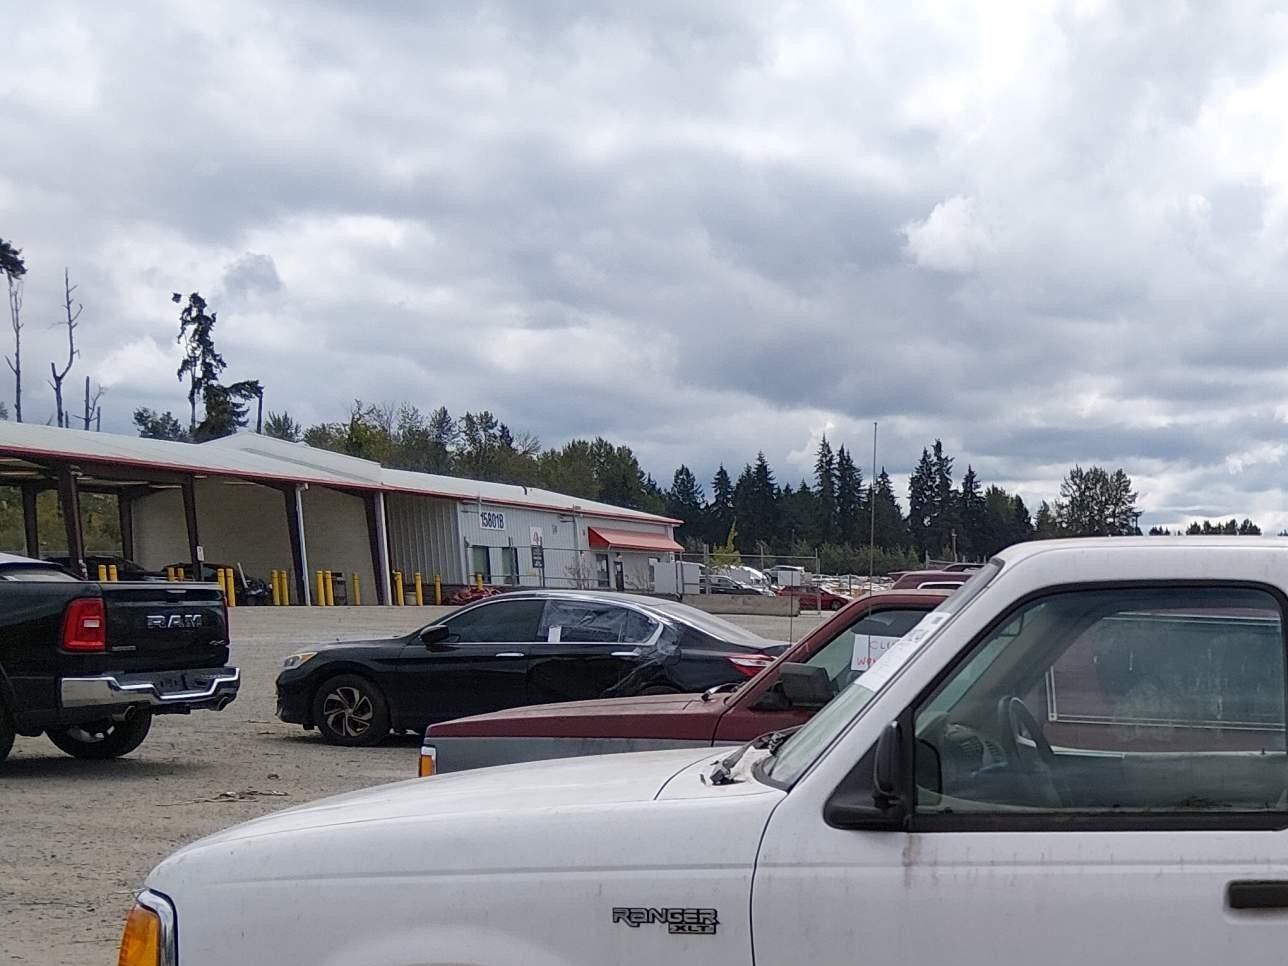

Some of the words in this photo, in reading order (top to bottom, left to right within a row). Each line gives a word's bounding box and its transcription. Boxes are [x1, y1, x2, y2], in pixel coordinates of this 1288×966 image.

[146, 614, 202, 629] RAM
[612, 907, 719, 927] RANGER
[671, 924, 714, 933] XLT
